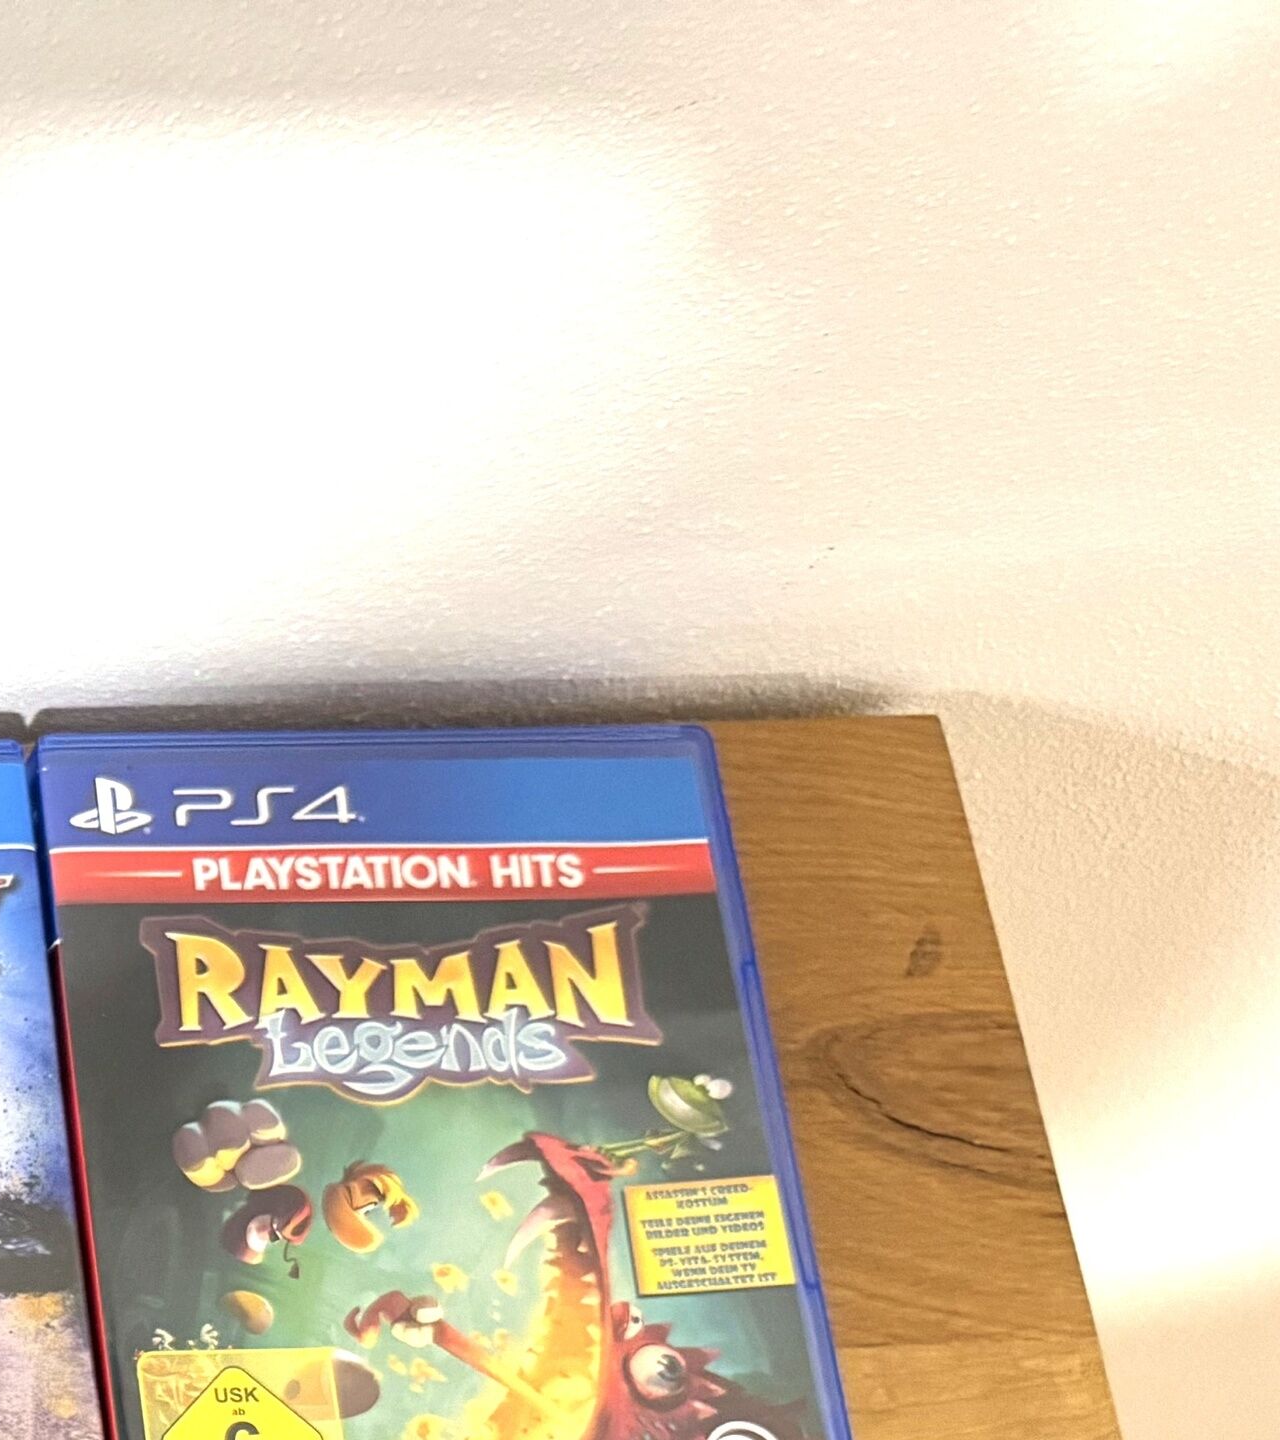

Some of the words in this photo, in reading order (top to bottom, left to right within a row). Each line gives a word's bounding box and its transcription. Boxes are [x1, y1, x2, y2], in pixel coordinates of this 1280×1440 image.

[173, 784, 357, 827] PS4
[192, 854, 472, 891] PLAYSTATION
[489, 853, 586, 889] HITS
[165, 921, 635, 1032] RAYMAN
[255, 1006, 570, 1094] Legends
[214, 1386, 260, 1404] USK
[231, 1407, 246, 1417] ab
